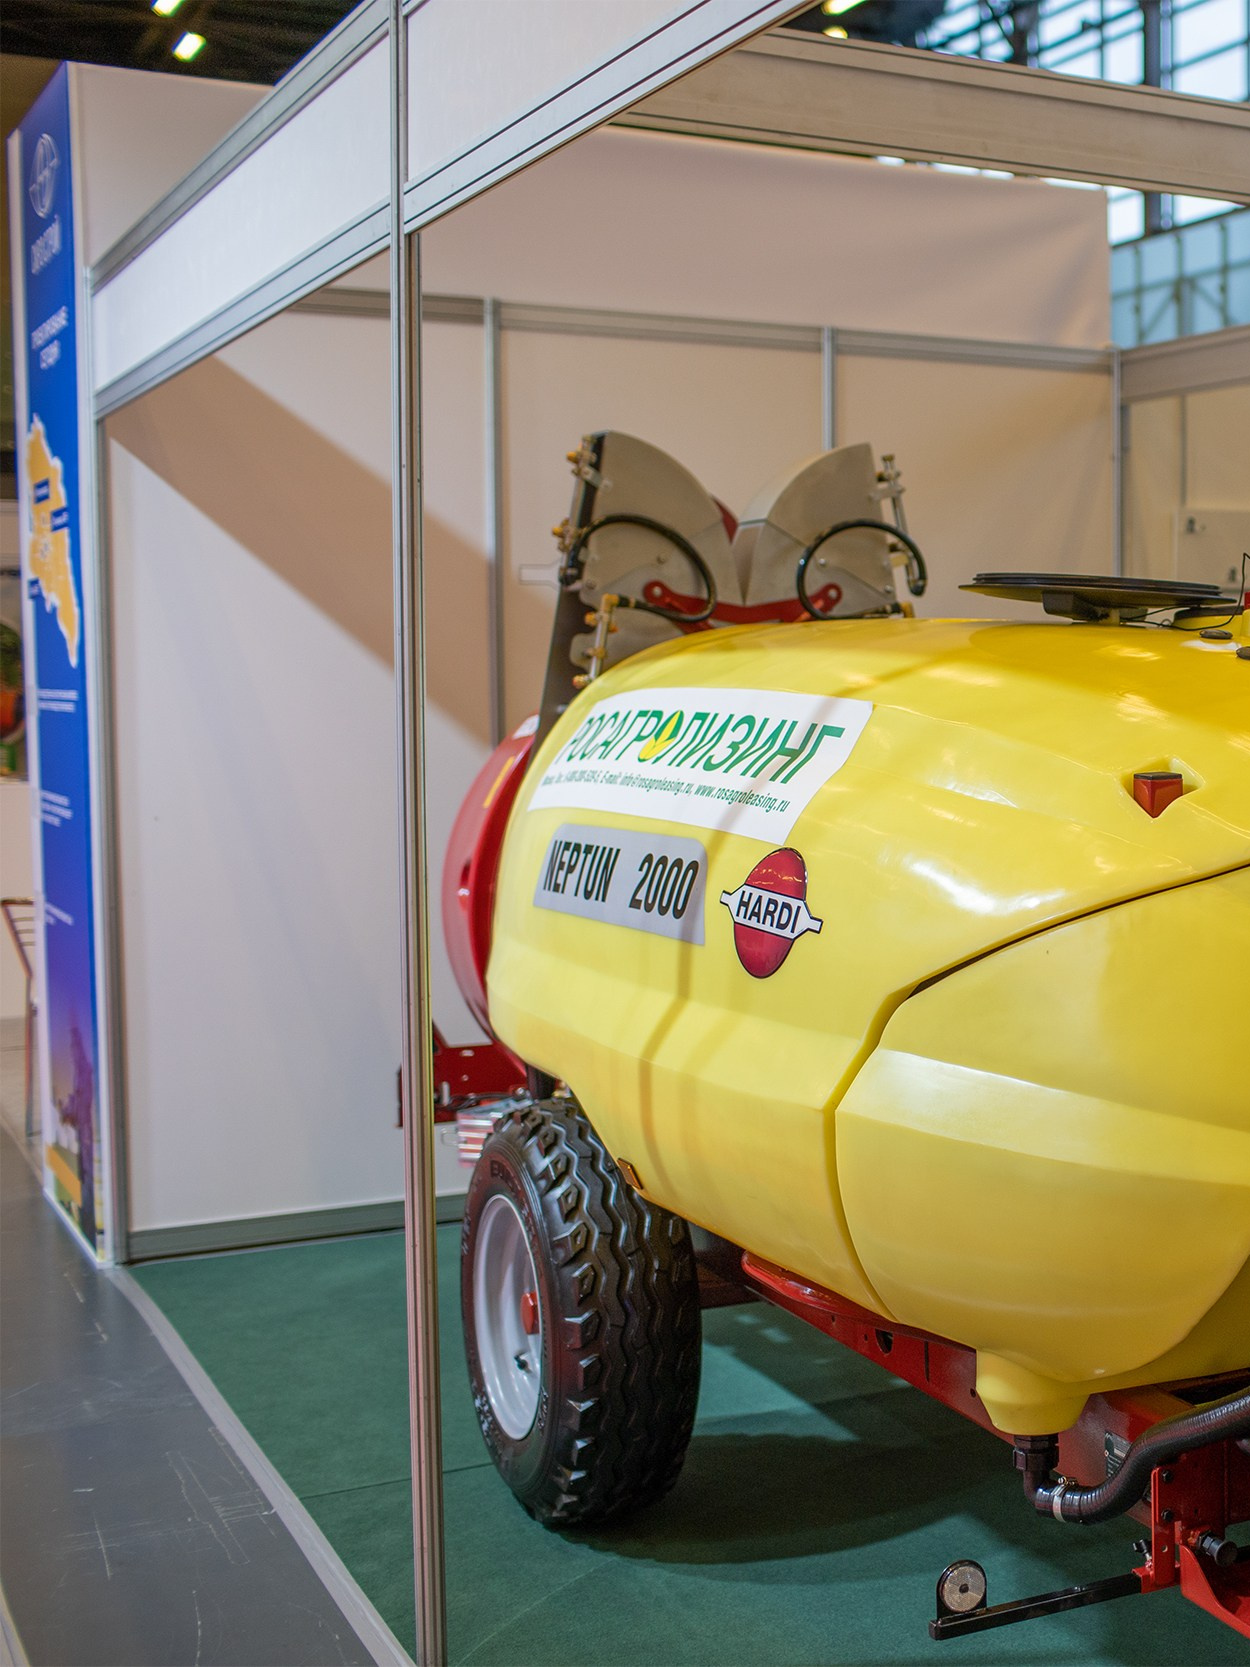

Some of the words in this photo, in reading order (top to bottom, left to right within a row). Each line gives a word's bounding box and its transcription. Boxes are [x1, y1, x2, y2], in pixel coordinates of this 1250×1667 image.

[694, 784, 791, 812] www.rosagroleasing.ru
[543, 840, 621, 902] NEPTUN
[628, 853, 700, 920] 2000
[736, 889, 802, 935] HARDI
